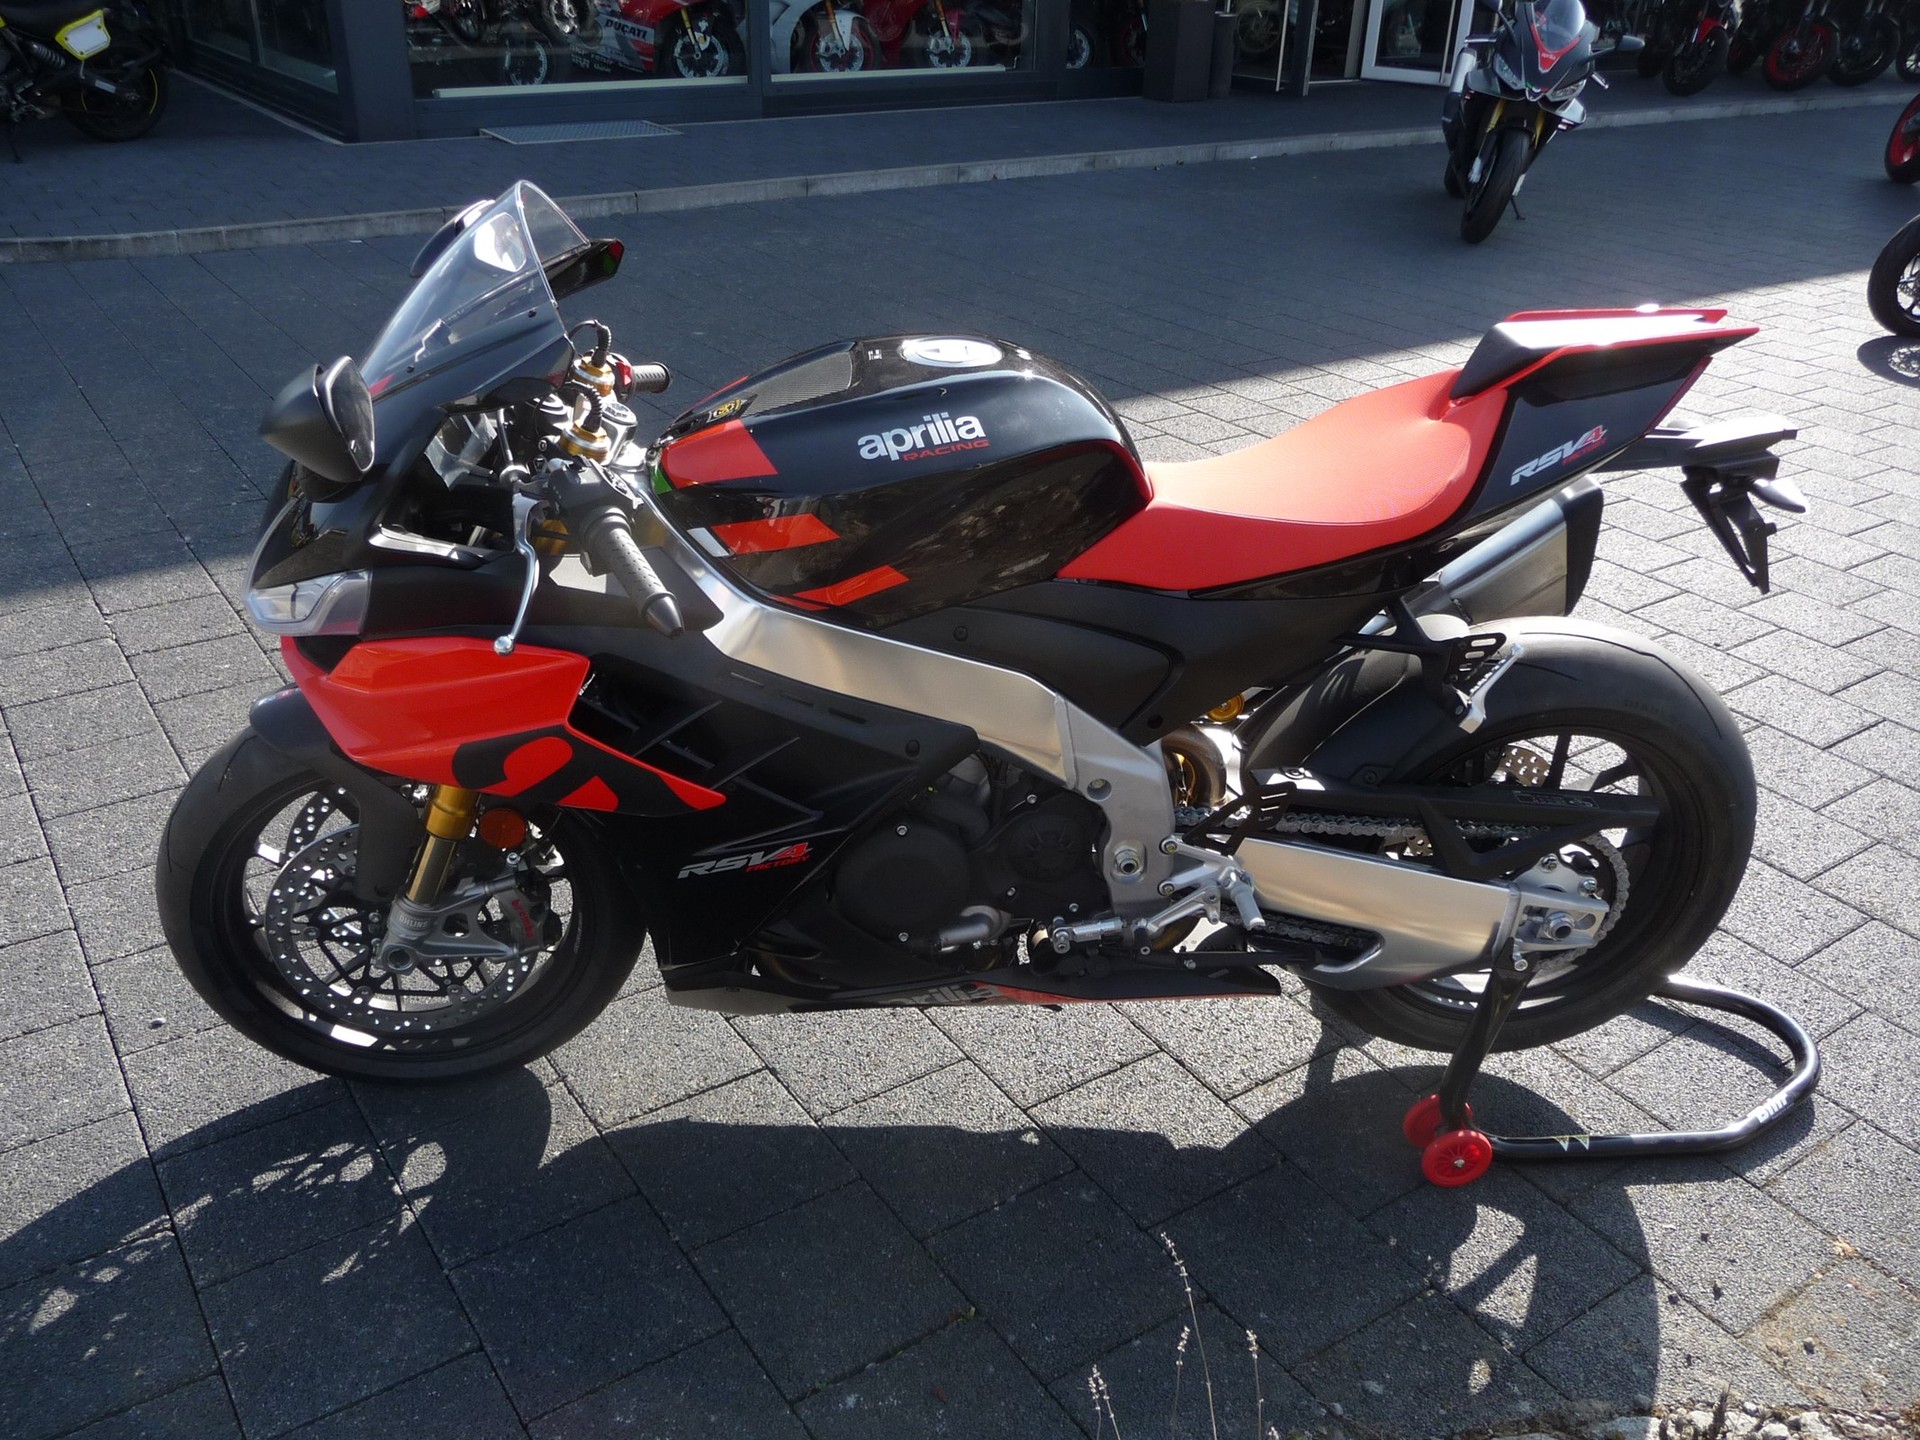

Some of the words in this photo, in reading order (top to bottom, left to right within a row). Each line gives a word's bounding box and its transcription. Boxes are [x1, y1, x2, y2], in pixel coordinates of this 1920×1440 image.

[605, 18, 648, 40] DUCATI
[857, 411, 986, 461] aprilia
[903, 439, 990, 461] RACING
[1510, 424, 1608, 486] RSV4
[677, 842, 813, 879] RSV4
